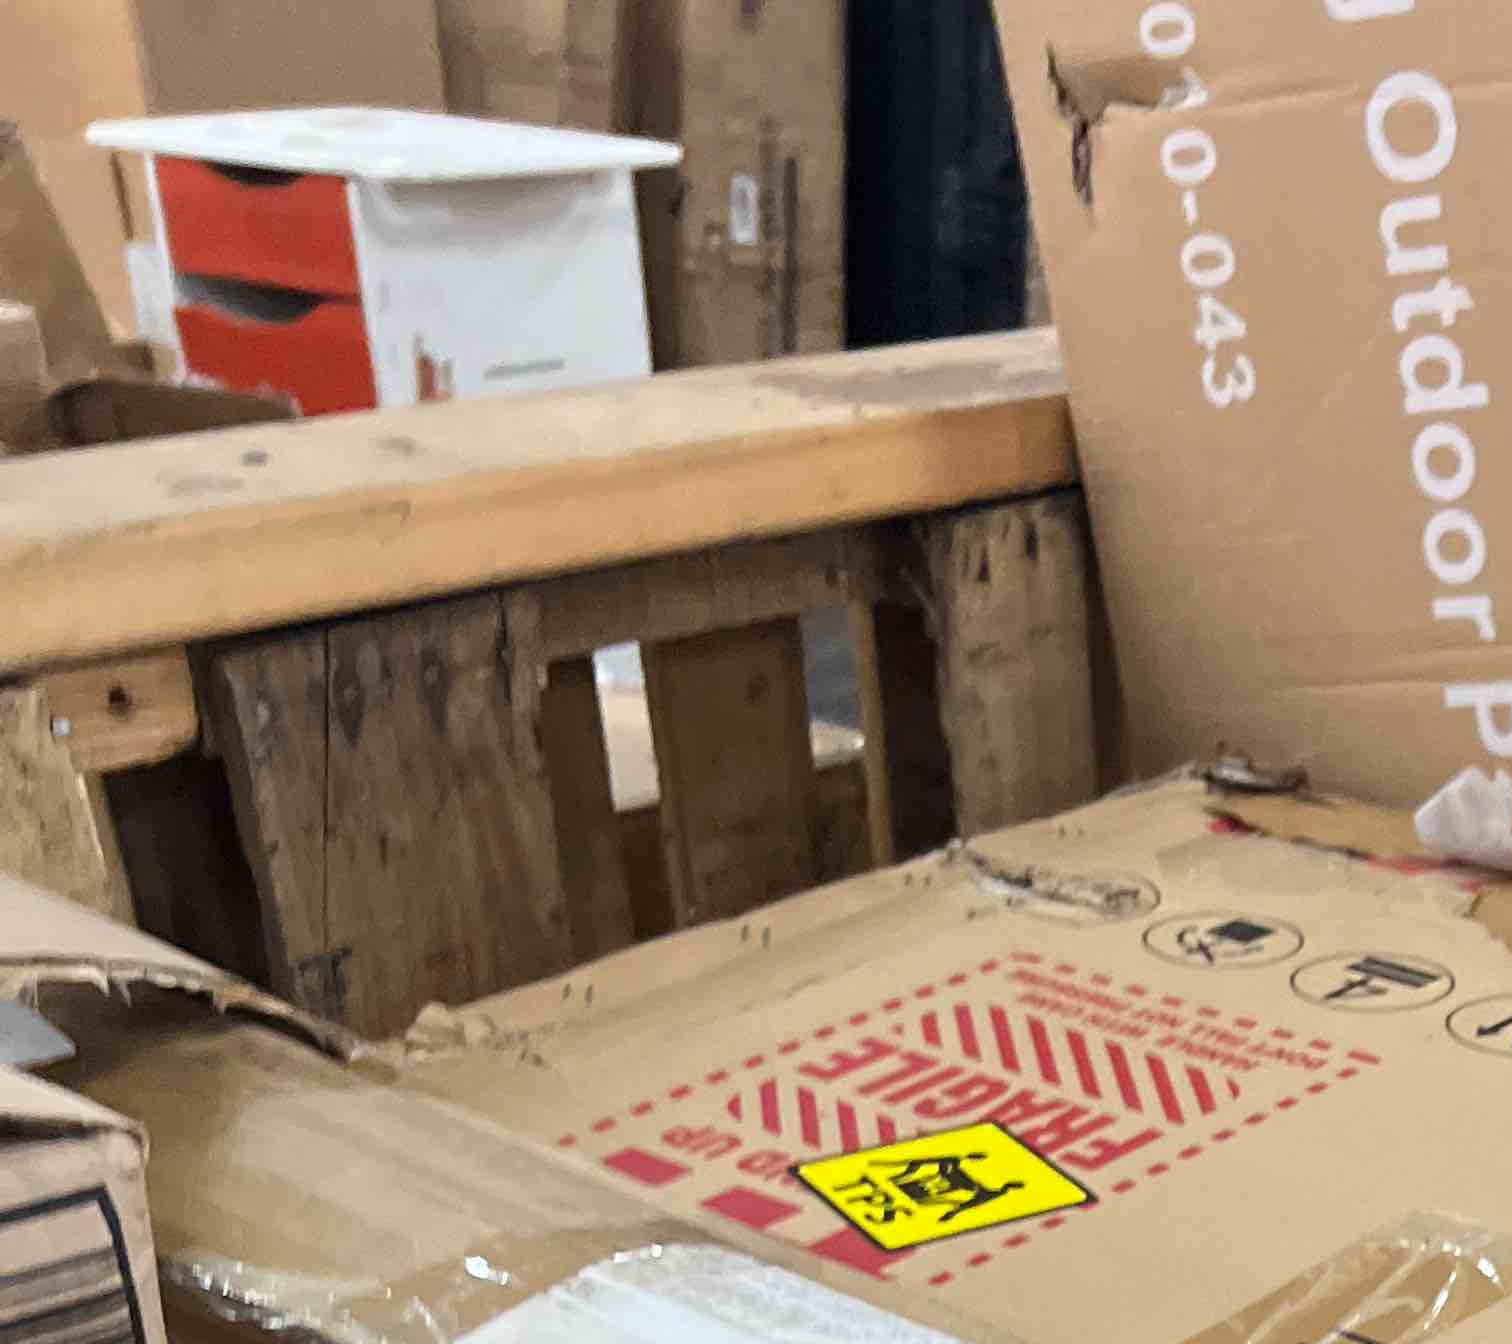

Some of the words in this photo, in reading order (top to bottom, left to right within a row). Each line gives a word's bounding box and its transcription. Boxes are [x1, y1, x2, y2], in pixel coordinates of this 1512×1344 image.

[1365, 70, 1496, 642] Outdoor
[660, 1125, 743, 1160] UP
[799, 1036, 1165, 1170] FRAGILE
